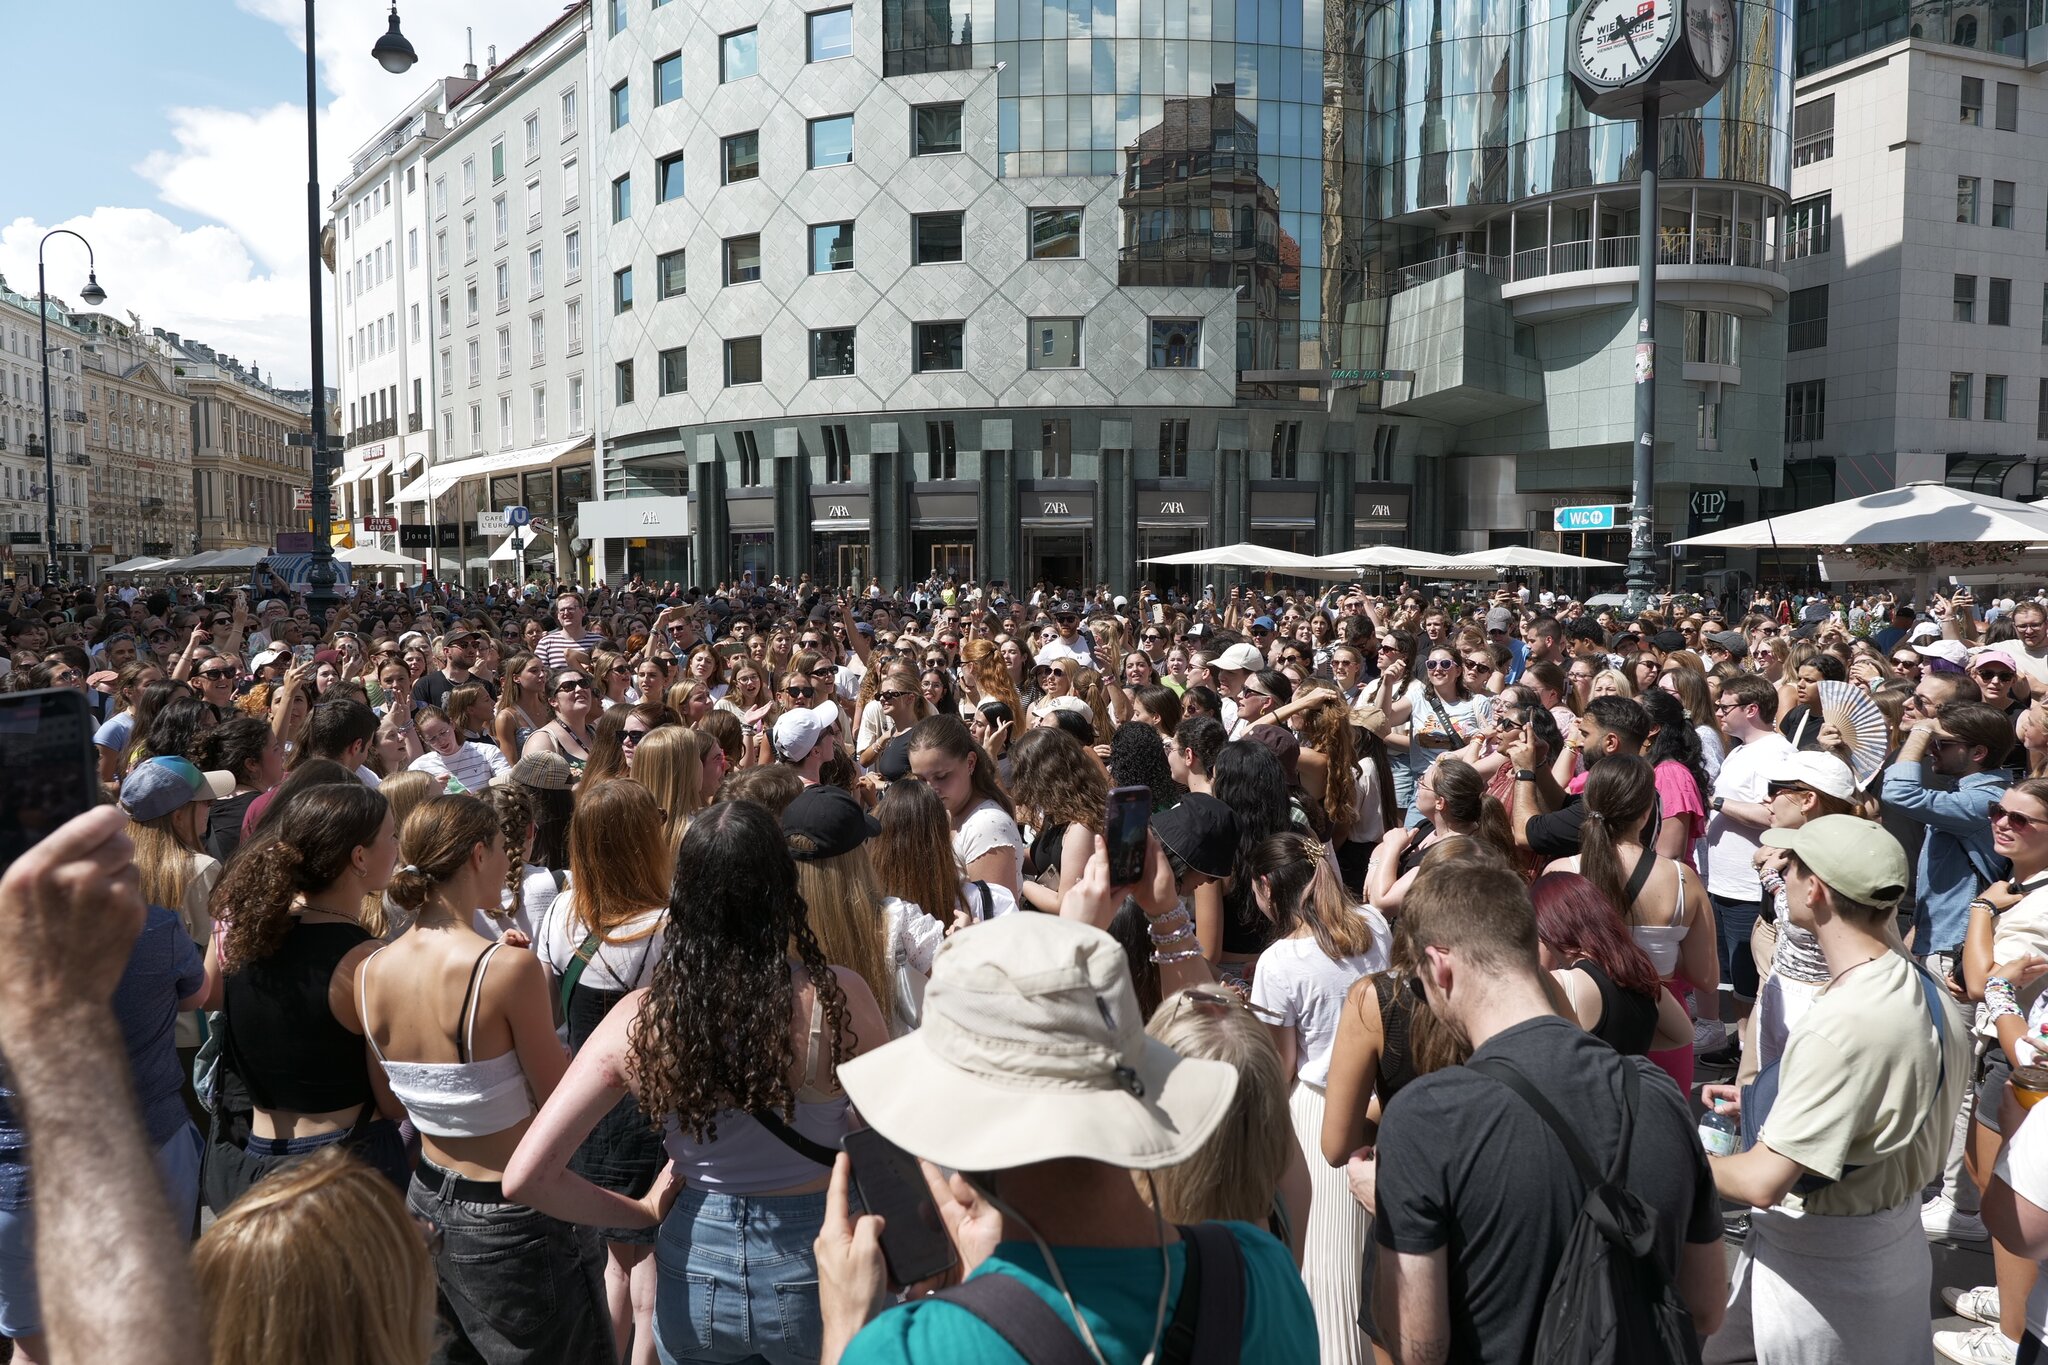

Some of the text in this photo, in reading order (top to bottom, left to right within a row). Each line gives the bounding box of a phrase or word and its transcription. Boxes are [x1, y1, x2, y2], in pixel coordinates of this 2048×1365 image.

[1597, 16, 1637, 35] WIEER
[1331, 370, 1360, 379] HAAS
[829, 505, 850, 517] ZARA
[1044, 502, 1069, 514] ZARA
[1160, 502, 1185, 513] ZARA
[1371, 504, 1390, 516] ZARA
[514, 510, 527, 524] U
[1569, 511, 1590, 525] WC
